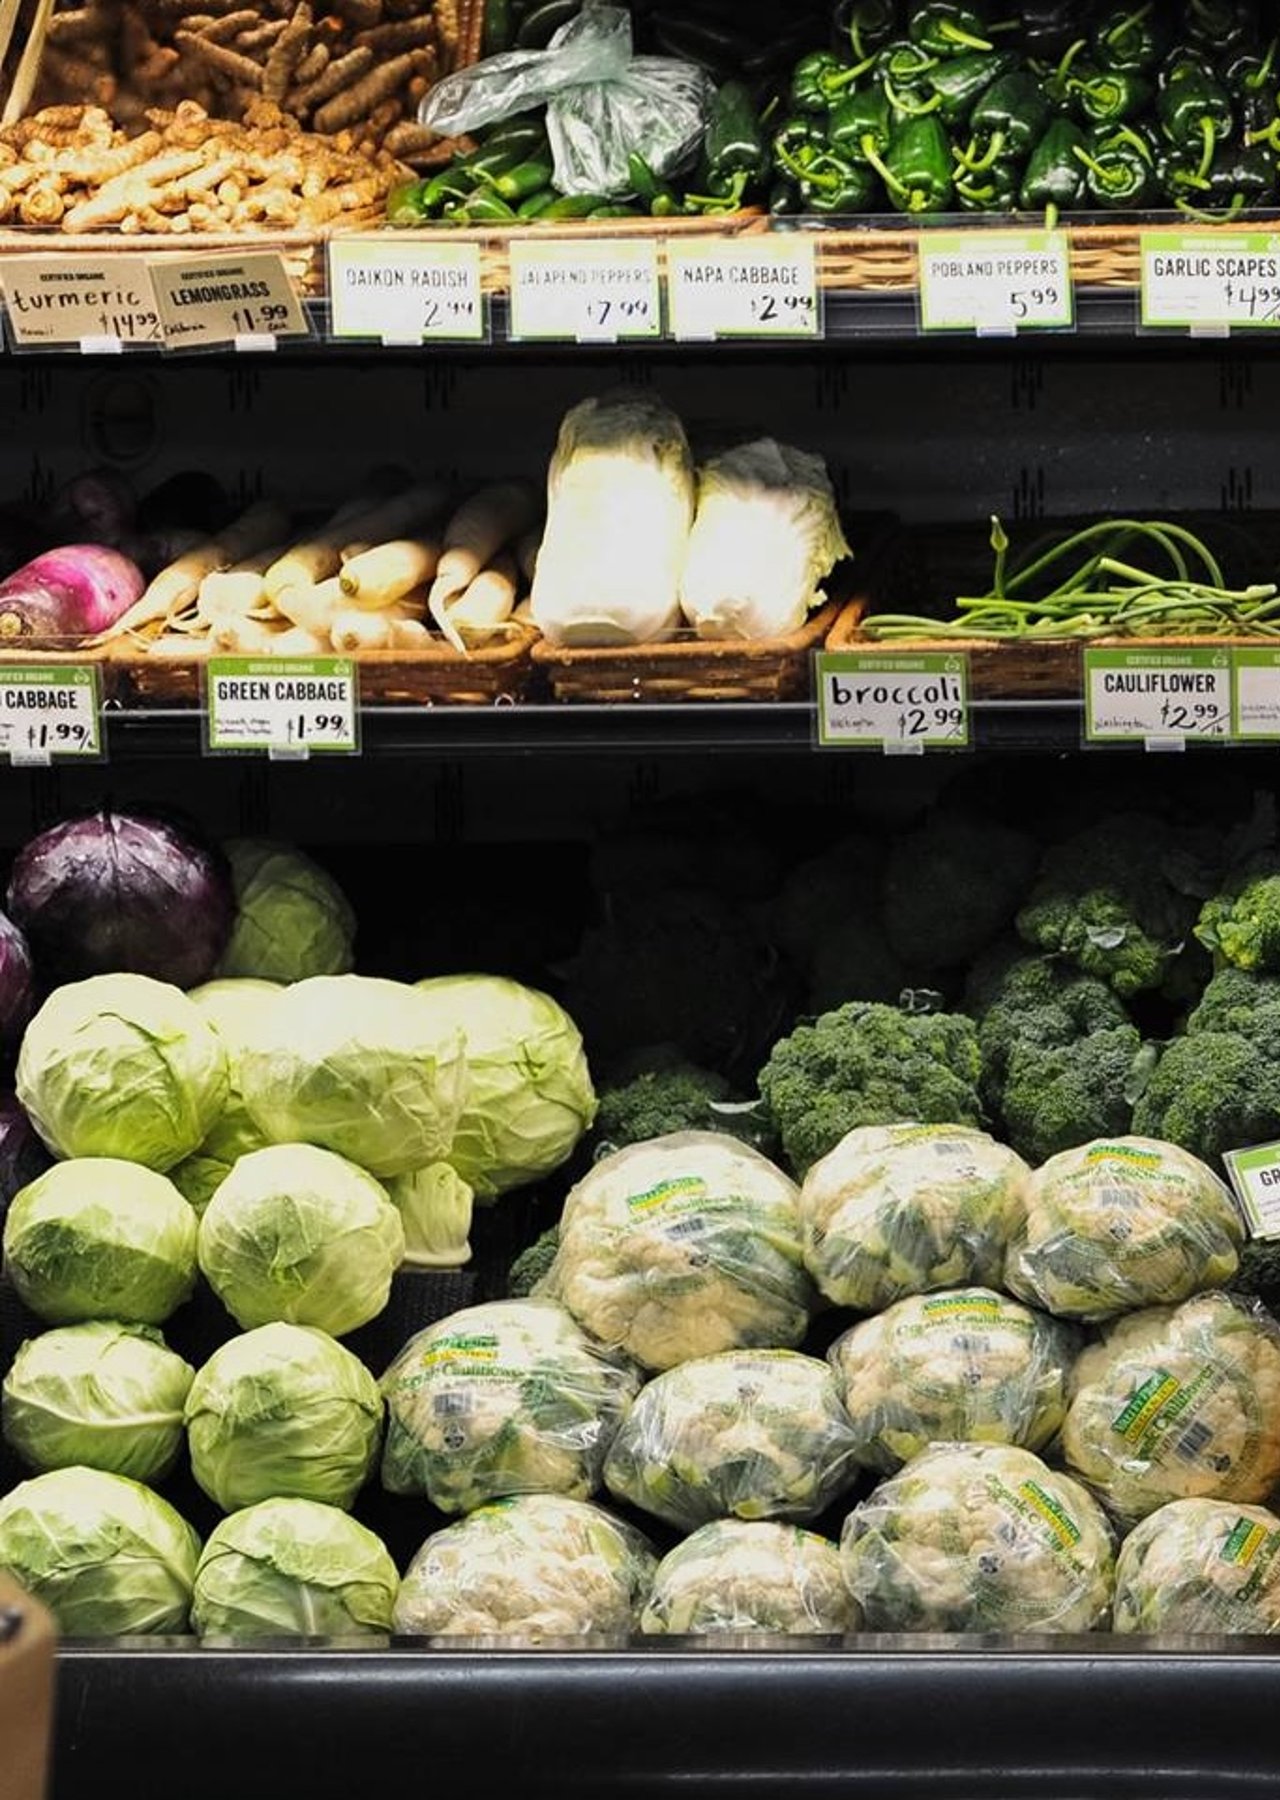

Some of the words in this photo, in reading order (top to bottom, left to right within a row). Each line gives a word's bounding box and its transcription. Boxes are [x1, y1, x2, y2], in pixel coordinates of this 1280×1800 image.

[346, 268, 405, 288] DAIKON
[410, 269, 468, 288] RADISH
[683, 268, 723, 285] NAPA
[730, 267, 799, 285] CABBAGE
[932, 261, 993, 278] POBLANO
[998, 259, 1059, 276] PEPPERS
[1154, 258, 1210, 278] GARLIC
[1216, 258, 1277, 278] SCAPES
[13, 285, 141, 312] turmeric
[170, 281, 270, 307] LEMONGRASS
[218, 682, 270, 701] GREEN
[275, 682, 347, 702] CABBAGE
[831, 676, 960, 706] broccoli
[1104, 673, 1216, 693] CAULIFLOWER
[5, 690, 78, 709] CABBAGE
